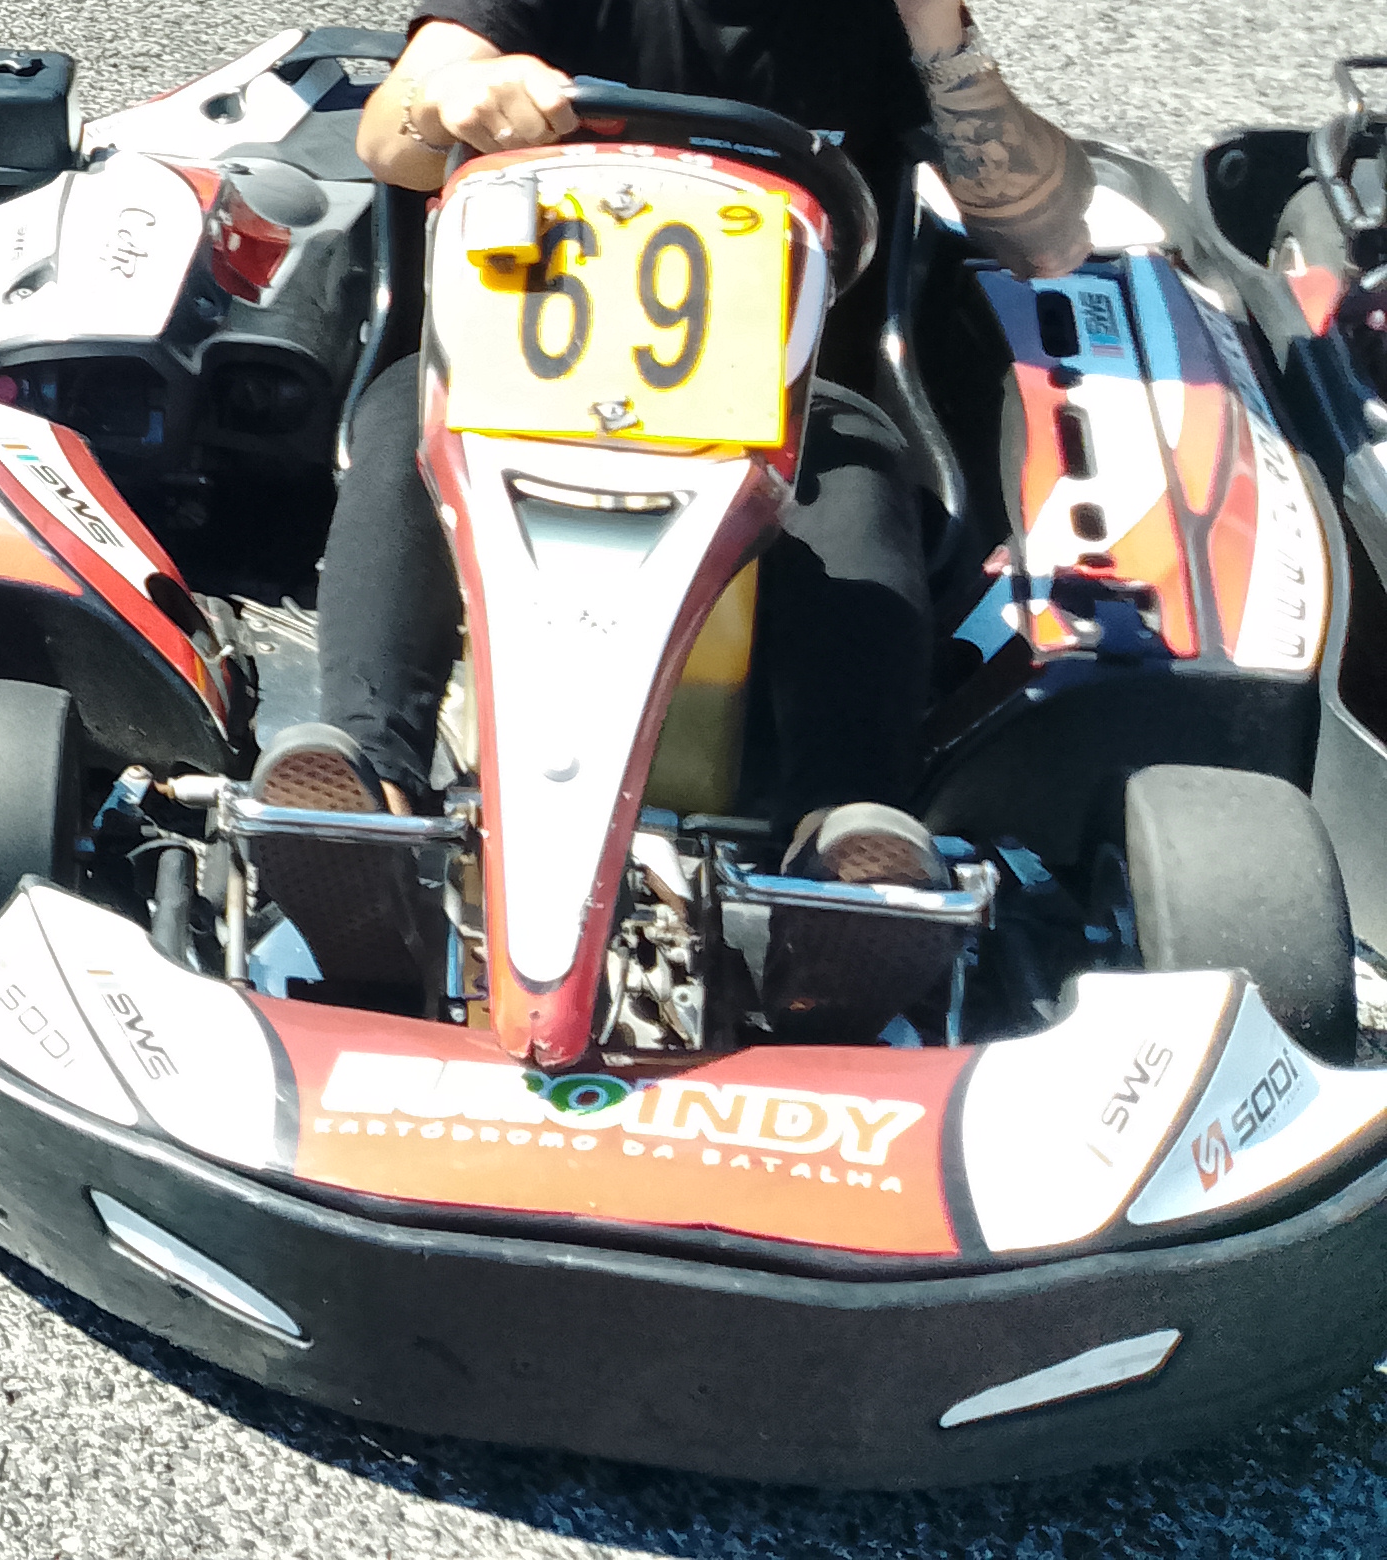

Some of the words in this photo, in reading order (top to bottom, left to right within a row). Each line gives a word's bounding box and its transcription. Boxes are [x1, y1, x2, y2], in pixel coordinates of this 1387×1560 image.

[522, 219, 713, 390] 69
[30, 463, 125, 549] SWS
[99, 991, 179, 1080] SWS
[623, 1140, 674, 1161] DA
[703, 1151, 904, 1195] BATALHA
